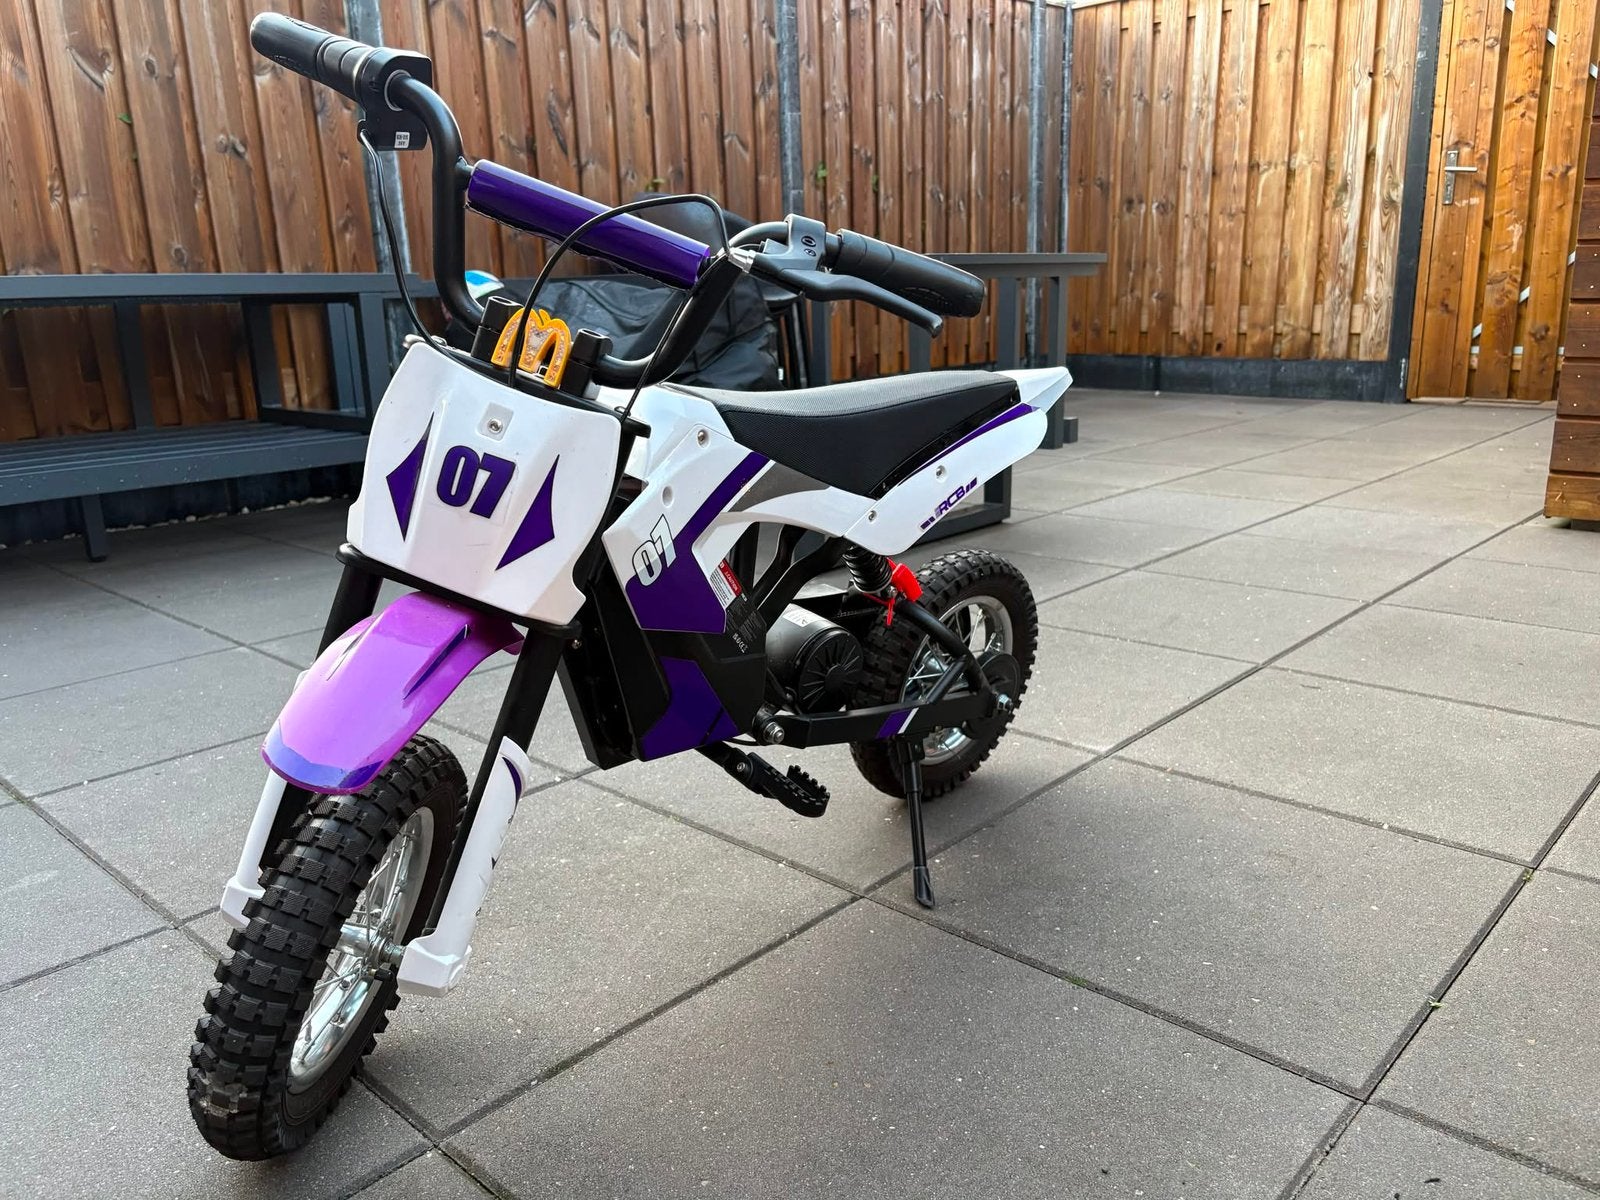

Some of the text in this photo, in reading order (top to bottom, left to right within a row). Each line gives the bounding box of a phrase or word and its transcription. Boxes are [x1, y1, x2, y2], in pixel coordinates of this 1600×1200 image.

[437, 445, 516, 518] 07
[937, 486, 966, 516] RCB
[632, 513, 676, 587] 07
